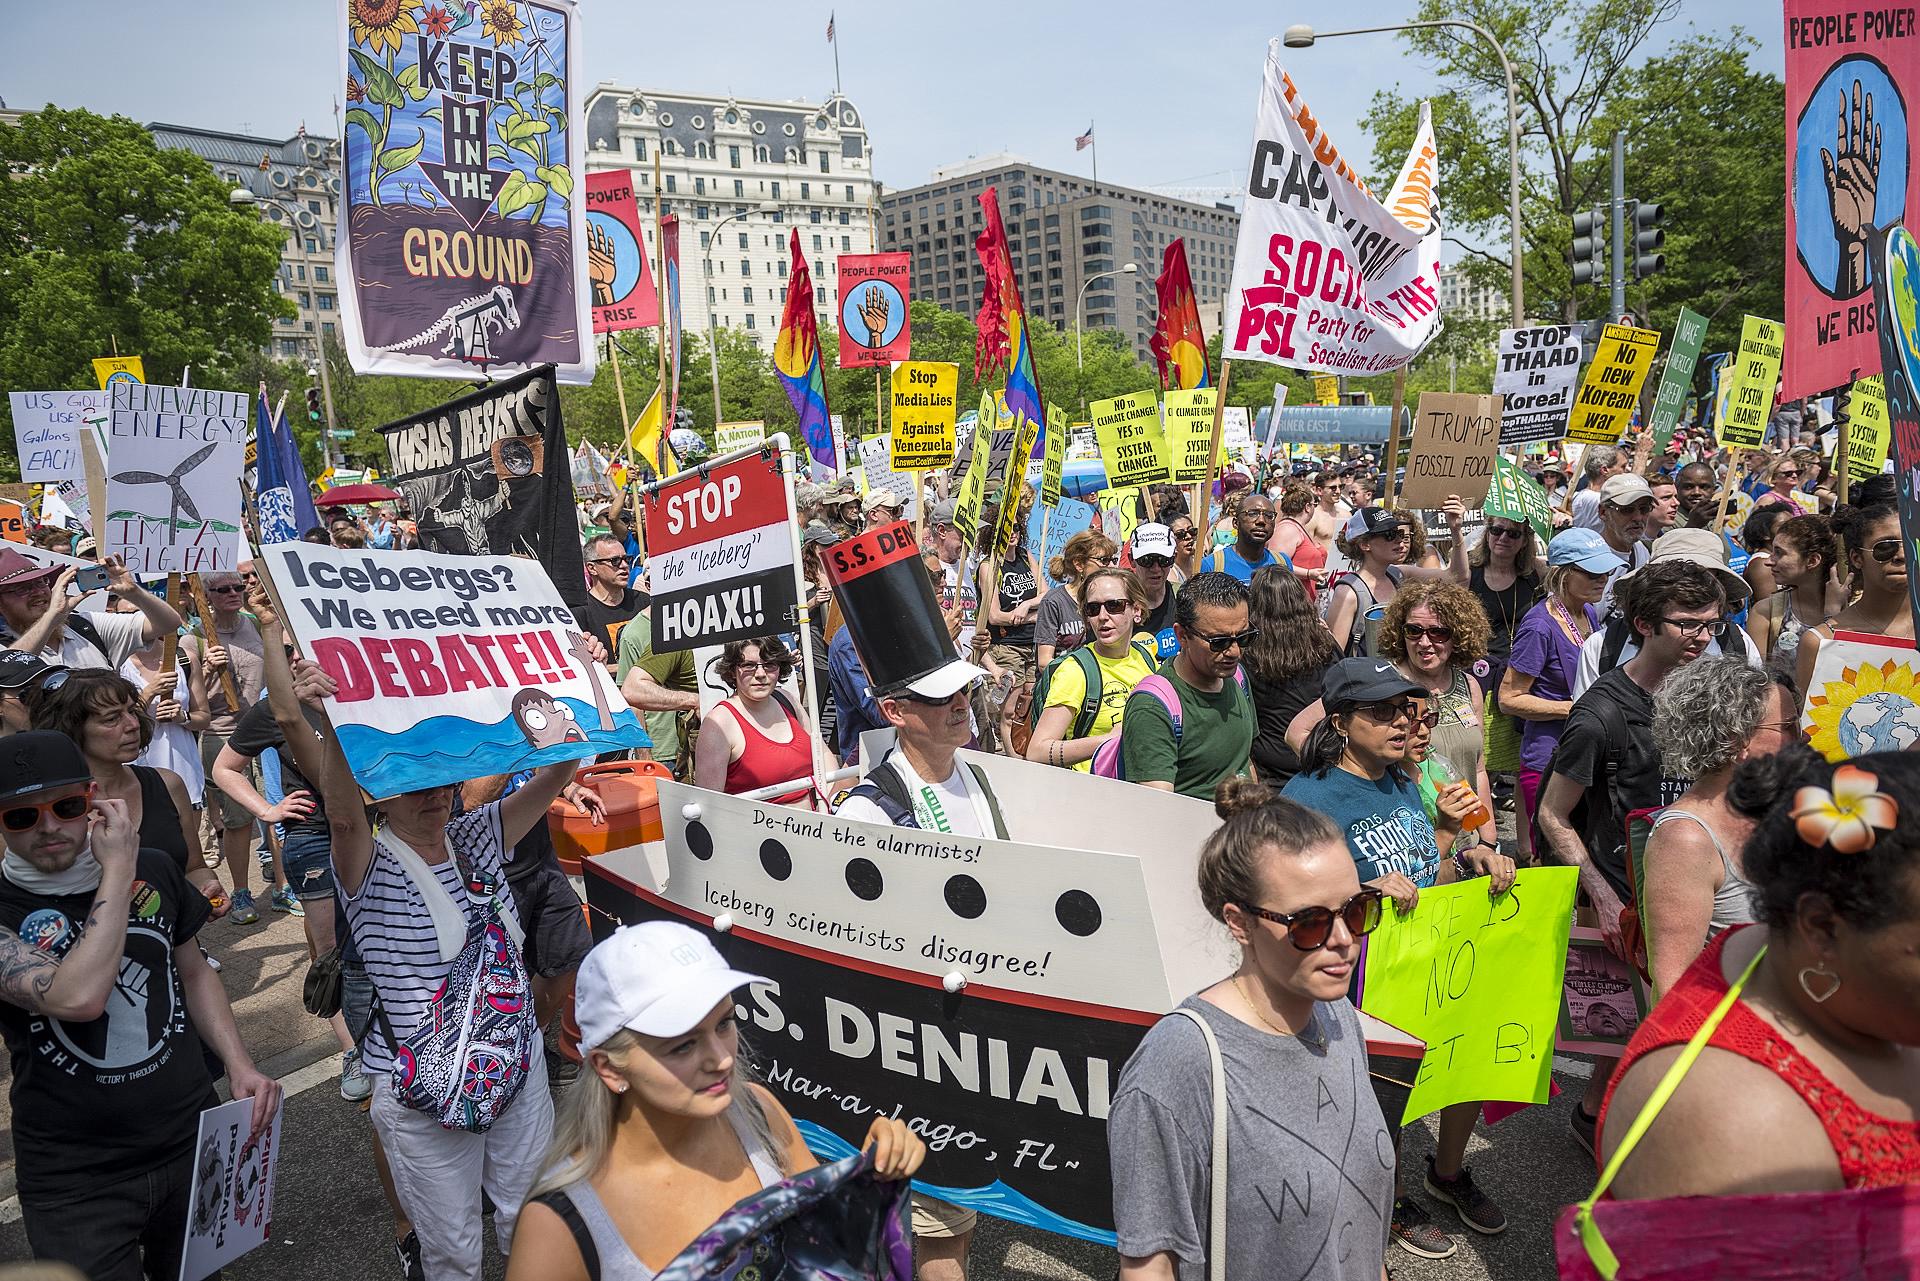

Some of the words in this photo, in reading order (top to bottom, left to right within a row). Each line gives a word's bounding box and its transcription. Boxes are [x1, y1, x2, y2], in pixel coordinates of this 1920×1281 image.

[1790, 13, 1856, 50] PEOPLE
[1864, 8, 1916, 40] POWER
[417, 35, 518, 101] KEEP
[453, 107, 479, 135] IT
[455, 140, 482, 166] IN
[443, 171, 493, 201] THE
[587, 187, 632, 206] POWER
[403, 228, 534, 285] GROUND
[841, 267, 875, 277] PEOPLE
[877, 265, 907, 276] POWER
[1387, 276, 1437, 323] THE
[604, 307, 637, 323] RISE
[1306, 309, 1351, 344] Party
[1352, 320, 1376, 343] for
[1816, 312, 1841, 346] WE
[1847, 303, 1876, 337] RIS
[1233, 300, 1298, 360] PSL
[1513, 326, 1573, 350] STOP
[1606, 327, 1633, 340] ANSWER
[1680, 320, 1700, 346] MAKE
[1757, 324, 1769, 338] NO
[1769, 330, 1774, 341] TO
[857, 352, 870, 361] WE
[872, 350, 894, 361] RISE
[1308, 341, 1368, 371] Socialism
[1366, 353, 1380, 371] &
[1501, 347, 1579, 373] THAAD
[1614, 343, 1638, 365] No
[1742, 340, 1763, 356] CLIMATE
[1764, 343, 1781, 359] CHANGE!
[112, 363, 128, 371] SUN
[909, 368, 938, 388] Stop
[1600, 365, 1635, 386] new
[1746, 360, 1762, 378] YES
[1527, 372, 1546, 387] in
[1855, 380, 1876, 397] CLIMATE
[1876, 386, 1886, 400] CHA
[24, 393, 56, 410] U.S.
[111, 382, 246, 420] RENEWABLE
[895, 392, 929, 407] Media
[930, 392, 953, 407] Lies
[1114, 399, 1125, 411] NO
[1127, 400, 1135, 408] TO
[1192, 394, 1202, 405] NO
[1203, 397, 1208, 405] TO
[1502, 386, 1569, 412] Korea!
[1579, 384, 1636, 410] Korean
[1660, 380, 1684, 407] GREEN
[1738, 387, 1764, 407] SYSTEM
[49, 412, 74, 423] USE
[1097, 412, 1125, 427] CLIMATE
[1126, 406, 1156, 420] CHANGE!
[1176, 407, 1200, 417] CLIMATE
[1201, 407, 1216, 416] CHAN
[1500, 412, 1567, 428] topTHAAD.org
[1584, 412, 1616, 431] war
[1733, 407, 1761, 427] CHANGE!
[1861, 400, 1874, 416] YES
[1874, 410, 1880, 420] TO
[22, 428, 70, 444] Gallons
[112, 411, 247, 443] ENERGY?
[458, 389, 533, 460] RESIST
[718, 432, 727, 445] A
[728, 428, 760, 442] NATION
[902, 421, 945, 438] Against
[1117, 425, 1133, 439] YES
[1134, 426, 1144, 436] TO
[1191, 421, 1204, 433] YES
[1205, 424, 1210, 433] TO
[1307, 419, 1330, 433] EAST
[1332, 420, 1341, 433] 2
[1427, 412, 1498, 447] TRUMP:
[1851, 424, 1878, 445] SYSTEM
[894, 438, 952, 453] Venezuela
[1116, 441, 1153, 459] SYSTEM
[1117, 455, 1158, 473] CHANGE!
[1185, 454, 1209, 467] CHANG
[1413, 455, 1456, 478] FOSSIL
[1461, 456, 1493, 479] FOOL
[57, 480, 76, 495] HEY
[1500, 467, 1522, 513] VOTE
[1517, 474, 1537, 518] RISE
[666, 474, 742, 536] STOP
[194, 520, 221, 546] A
[123, 547, 171, 572] BIG
[184, 546, 229, 571] FAN
[663, 555, 684, 581] the
[690, 532, 762, 570] "Iceberg"
[834, 543, 876, 575] S.S.
[282, 551, 514, 600] Icebergs?
[300, 598, 376, 631] We
[386, 600, 479, 630] need
[485, 602, 574, 627] more
[662, 584, 766, 642] HOAX!!
[1161, 636, 1176, 649] DC
[310, 630, 577, 703] DEBATE!!
[1661, 782, 1691, 791] STAN
[752, 808, 823, 840] De-fund
[832, 827, 866, 847] the
[876, 835, 982, 864] alarmists!
[1351, 813, 1383, 835] 2015
[1353, 817, 1415, 862] EARTH
[1479, 883, 1521, 929] IS
[704, 881, 775, 928] Iceberg
[786, 909, 906, 952] scientists
[920, 935, 1052, 979] disagree!
[1424, 939, 1476, 1017] NO
[734, 978, 804, 1041] .S.
[1494, 1022, 1537, 1065] B!
[39, 1041, 81, 1076] THE
[96, 1073, 129, 1085] VICTORY
[129, 1062, 159, 1081] THROUGH
[1316, 1075, 1340, 1123] A
[215, 1123, 239, 1250] Privatized
[254, 1124, 273, 1229] Socialize
[1254, 1170, 1312, 1224] W
